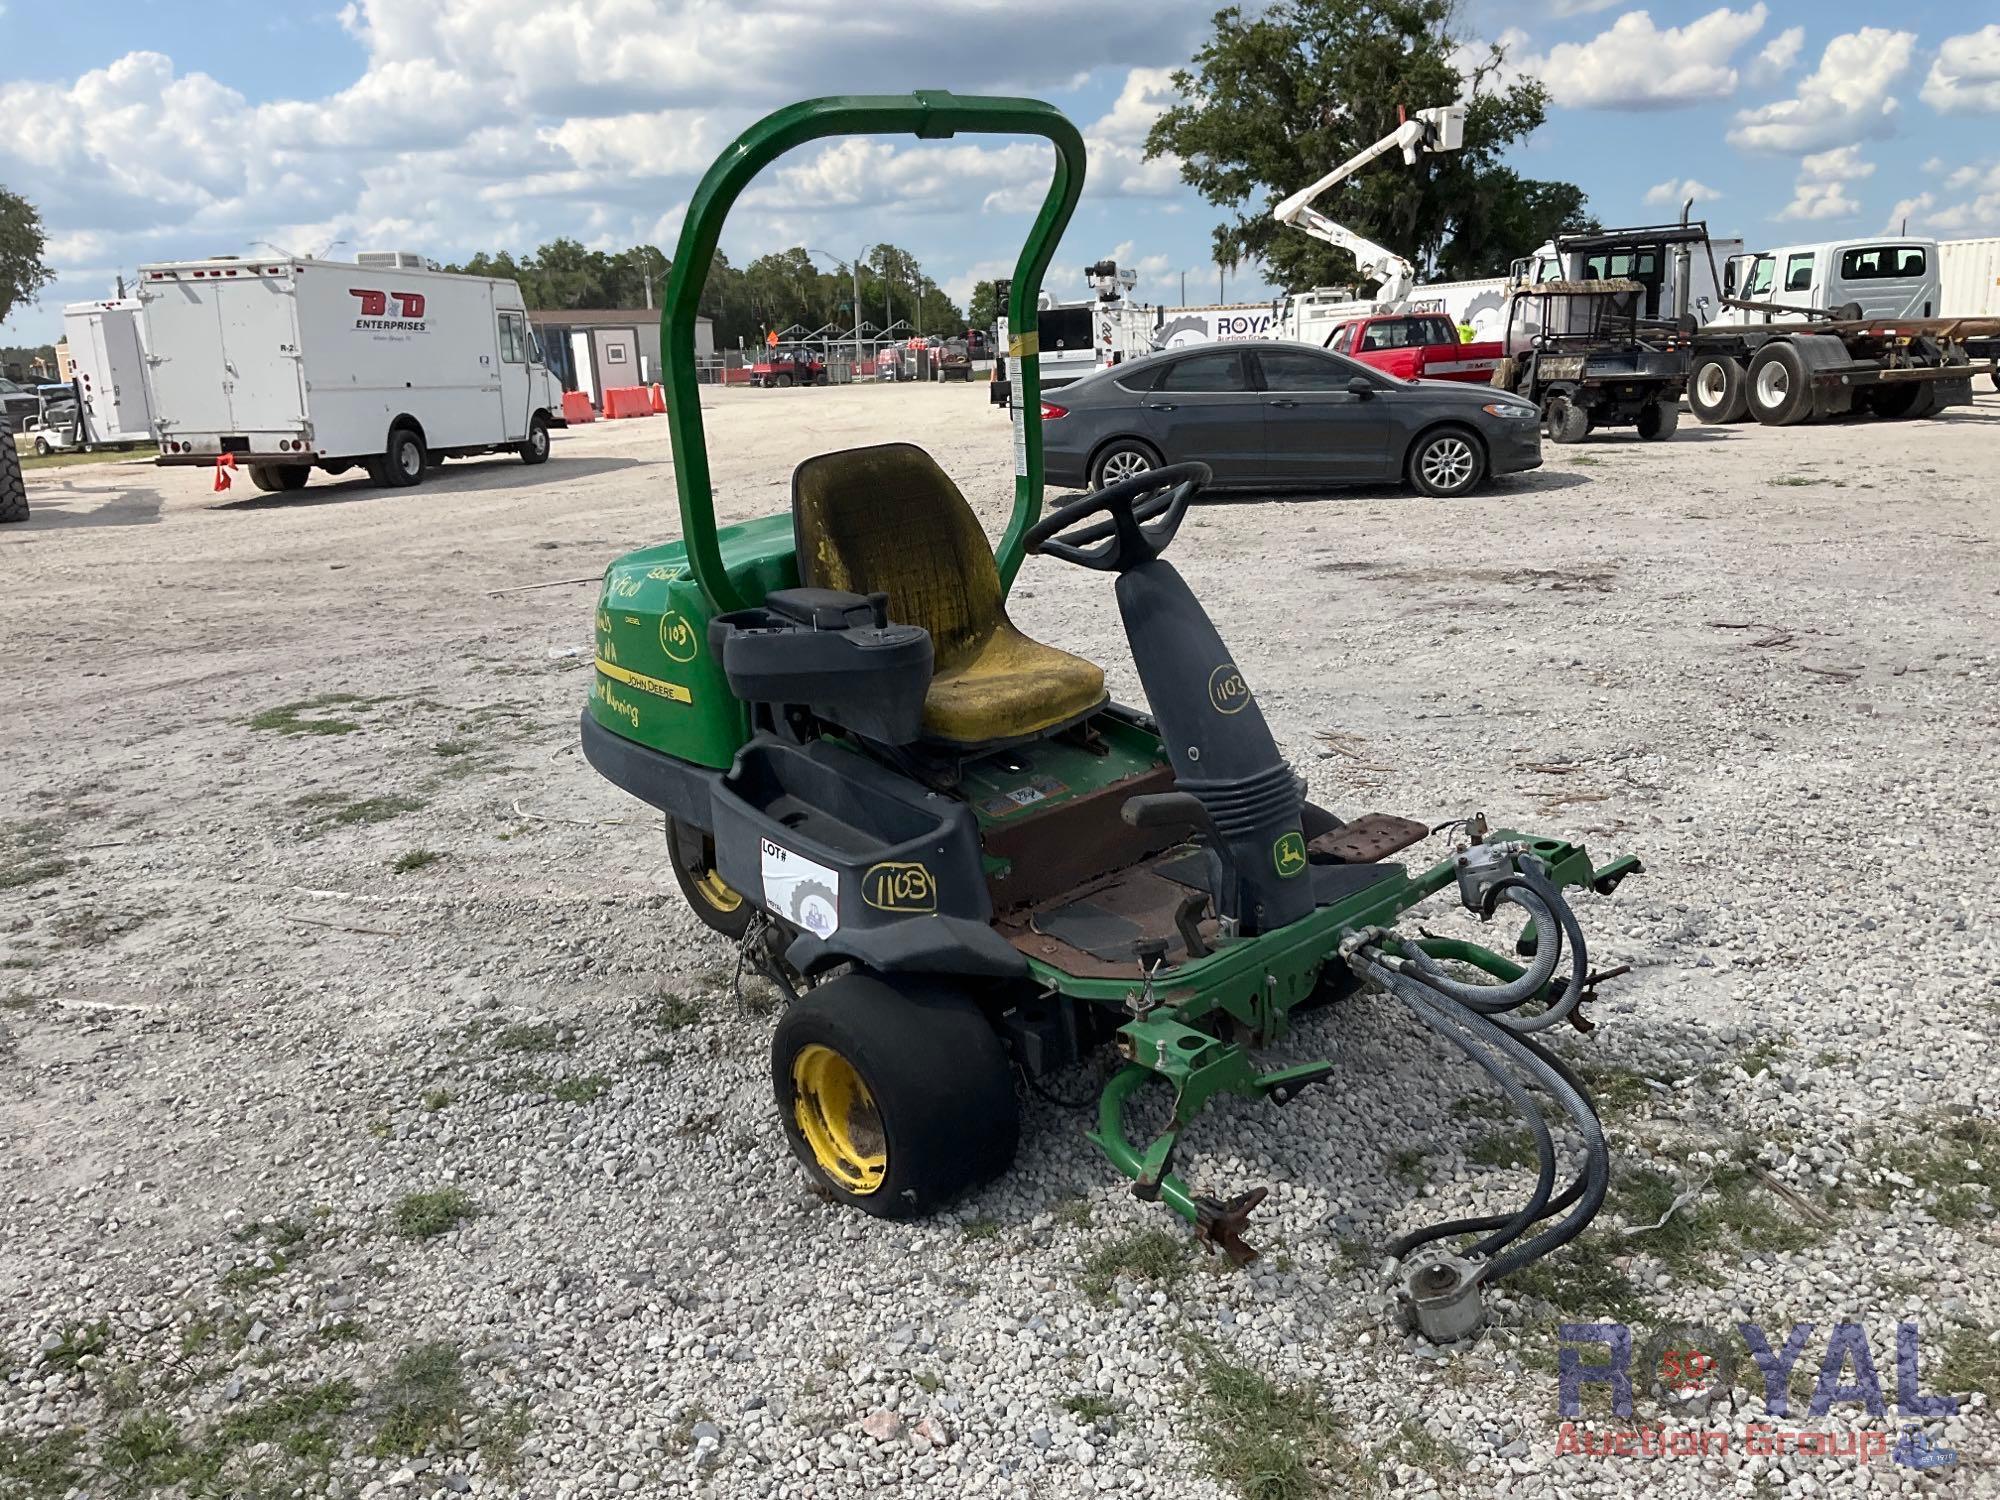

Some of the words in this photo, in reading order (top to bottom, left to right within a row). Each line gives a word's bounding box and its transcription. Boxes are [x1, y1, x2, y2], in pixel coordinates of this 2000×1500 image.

[356, 320, 425, 331] ENTERPRISES
[1218, 316, 1270, 334] ROYA
[625, 616, 641, 626] DIESEL
[664, 624, 687, 646] 1103
[628, 673, 647, 691] JOHN
[648, 680, 675, 699] DEERE
[1217, 675, 1247, 700] 1103
[762, 840, 787, 863] LOT#
[877, 870, 927, 906] 1103
